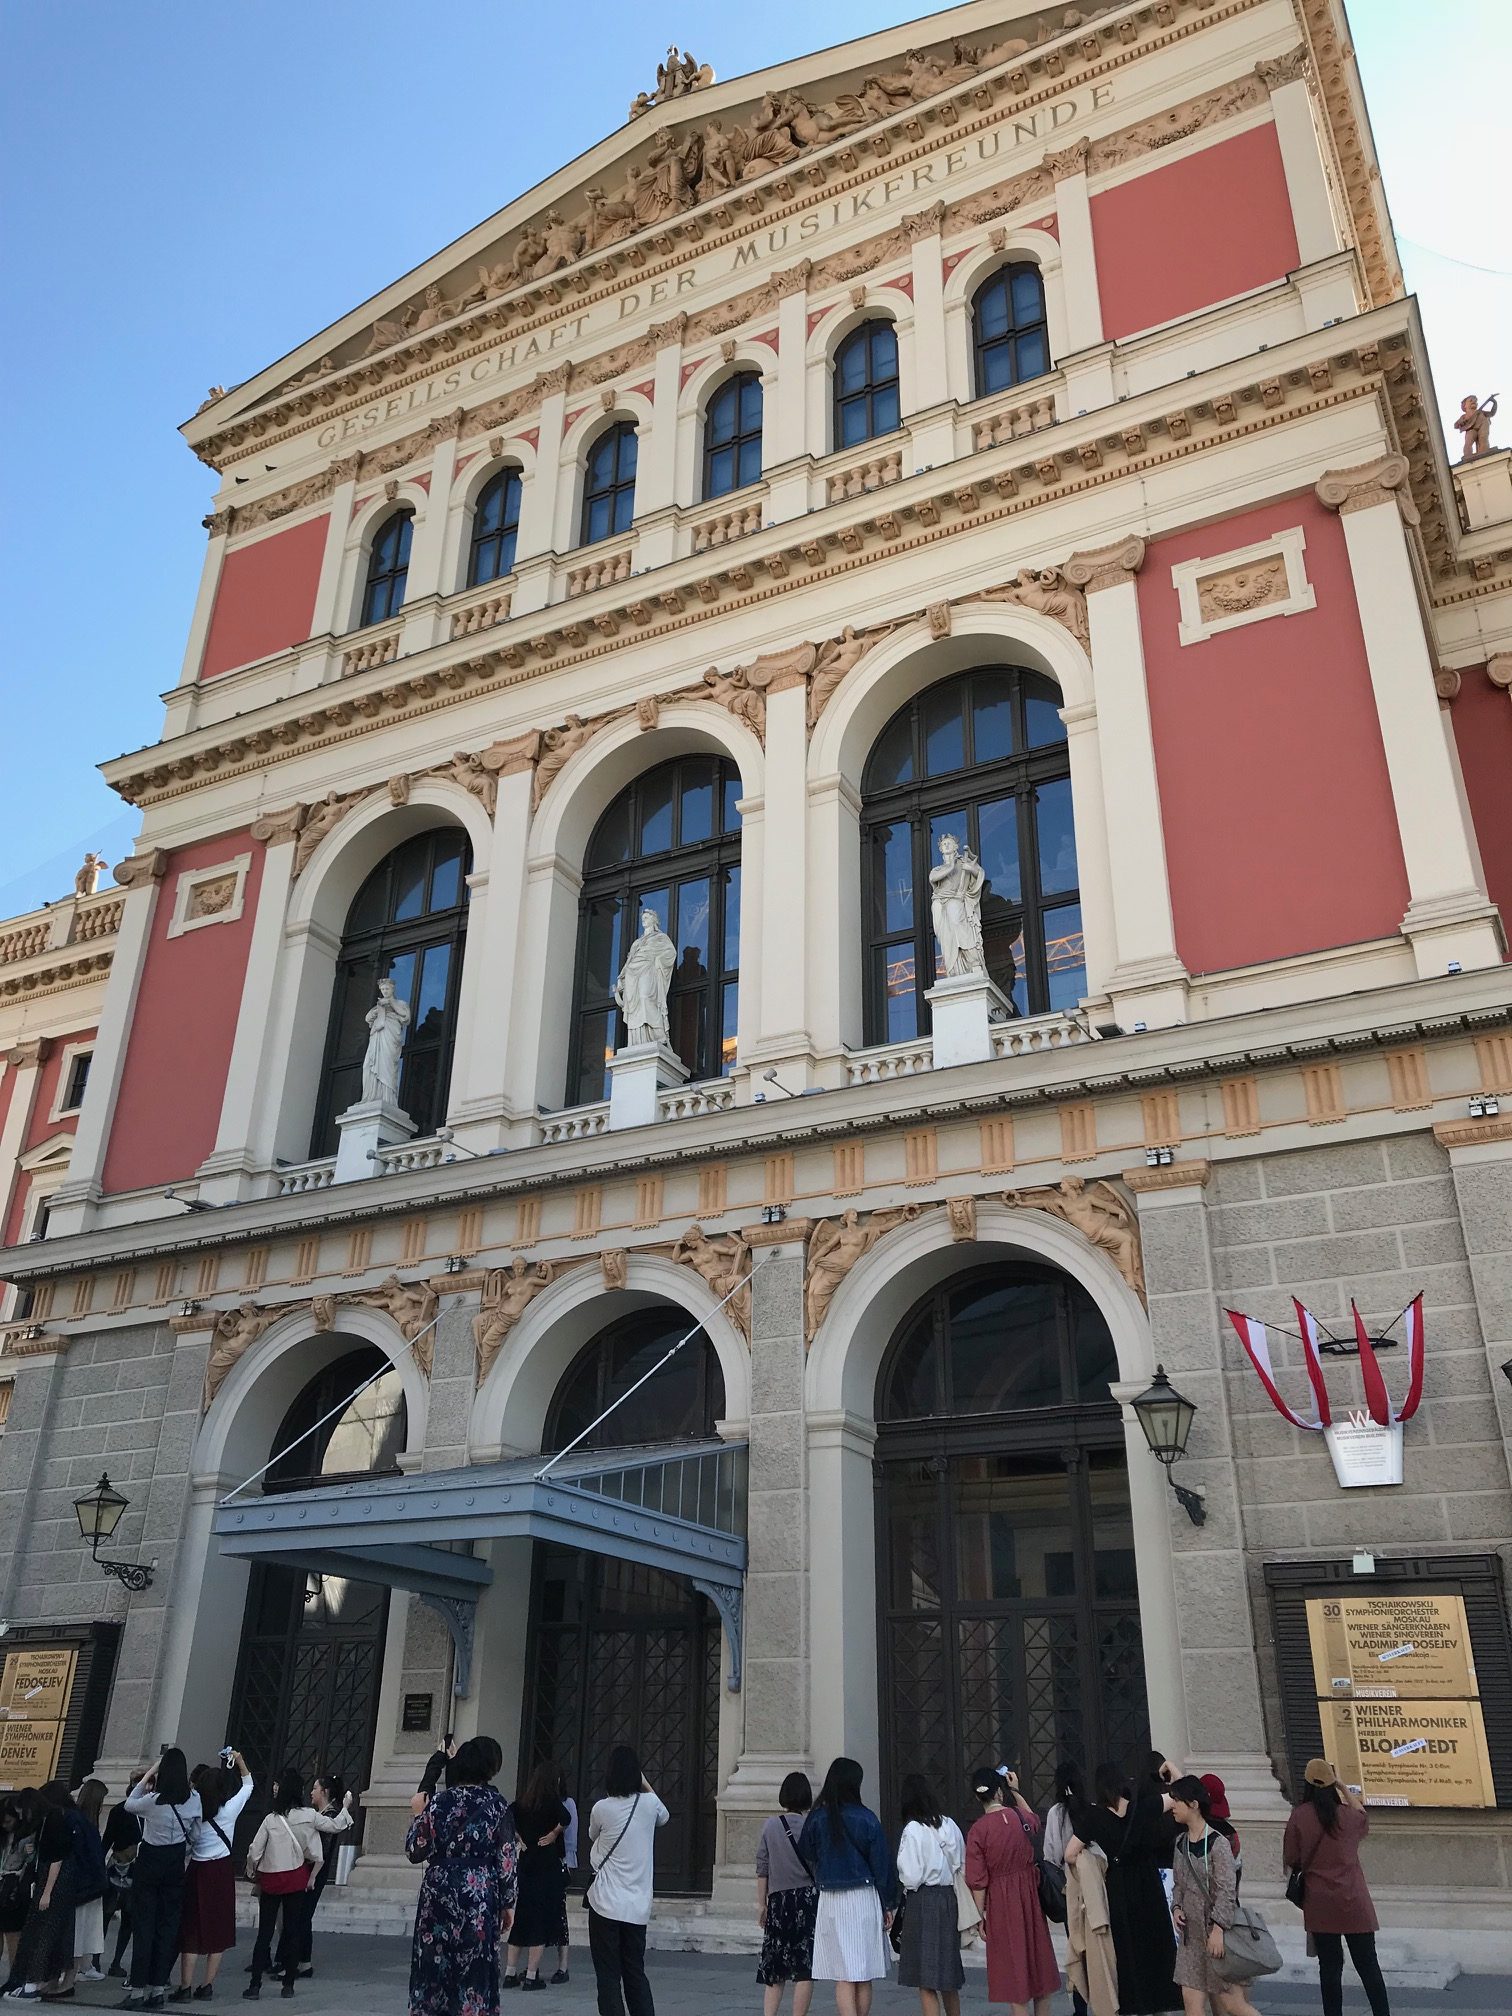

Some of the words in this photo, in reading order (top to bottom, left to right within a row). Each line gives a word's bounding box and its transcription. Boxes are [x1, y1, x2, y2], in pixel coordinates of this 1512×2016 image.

[317, 312, 591, 449] GESELLSCHAFT
[618, 268, 698, 320] DER
[730, 79, 1117, 270] MUSIKFREUNDE
[1323, 1604, 1341, 1616] 30
[1345, 1608, 1439, 1616] SYMPHONIEORCHESTER
[1347, 1623, 1379, 1631] WIENER
[1381, 1621, 1450, 1631] SÄNGERKNABEN
[1360, 1631, 1391, 1639] WIENER
[1394, 1630, 1444, 1639] SINGVEREIN
[1350, 1640, 1399, 1649] VLADIMIR
[15, 1676, 64, 1689] FEDOSEJEV
[1342, 1709, 1352, 1720] 2
[1355, 1705, 1402, 1716] WIENER
[7, 1724, 32, 1732] WIENER
[1357, 1717, 1468, 1729] PHILHARMONIKER
[4, 1732, 54, 1741] SYMPHONIKER
